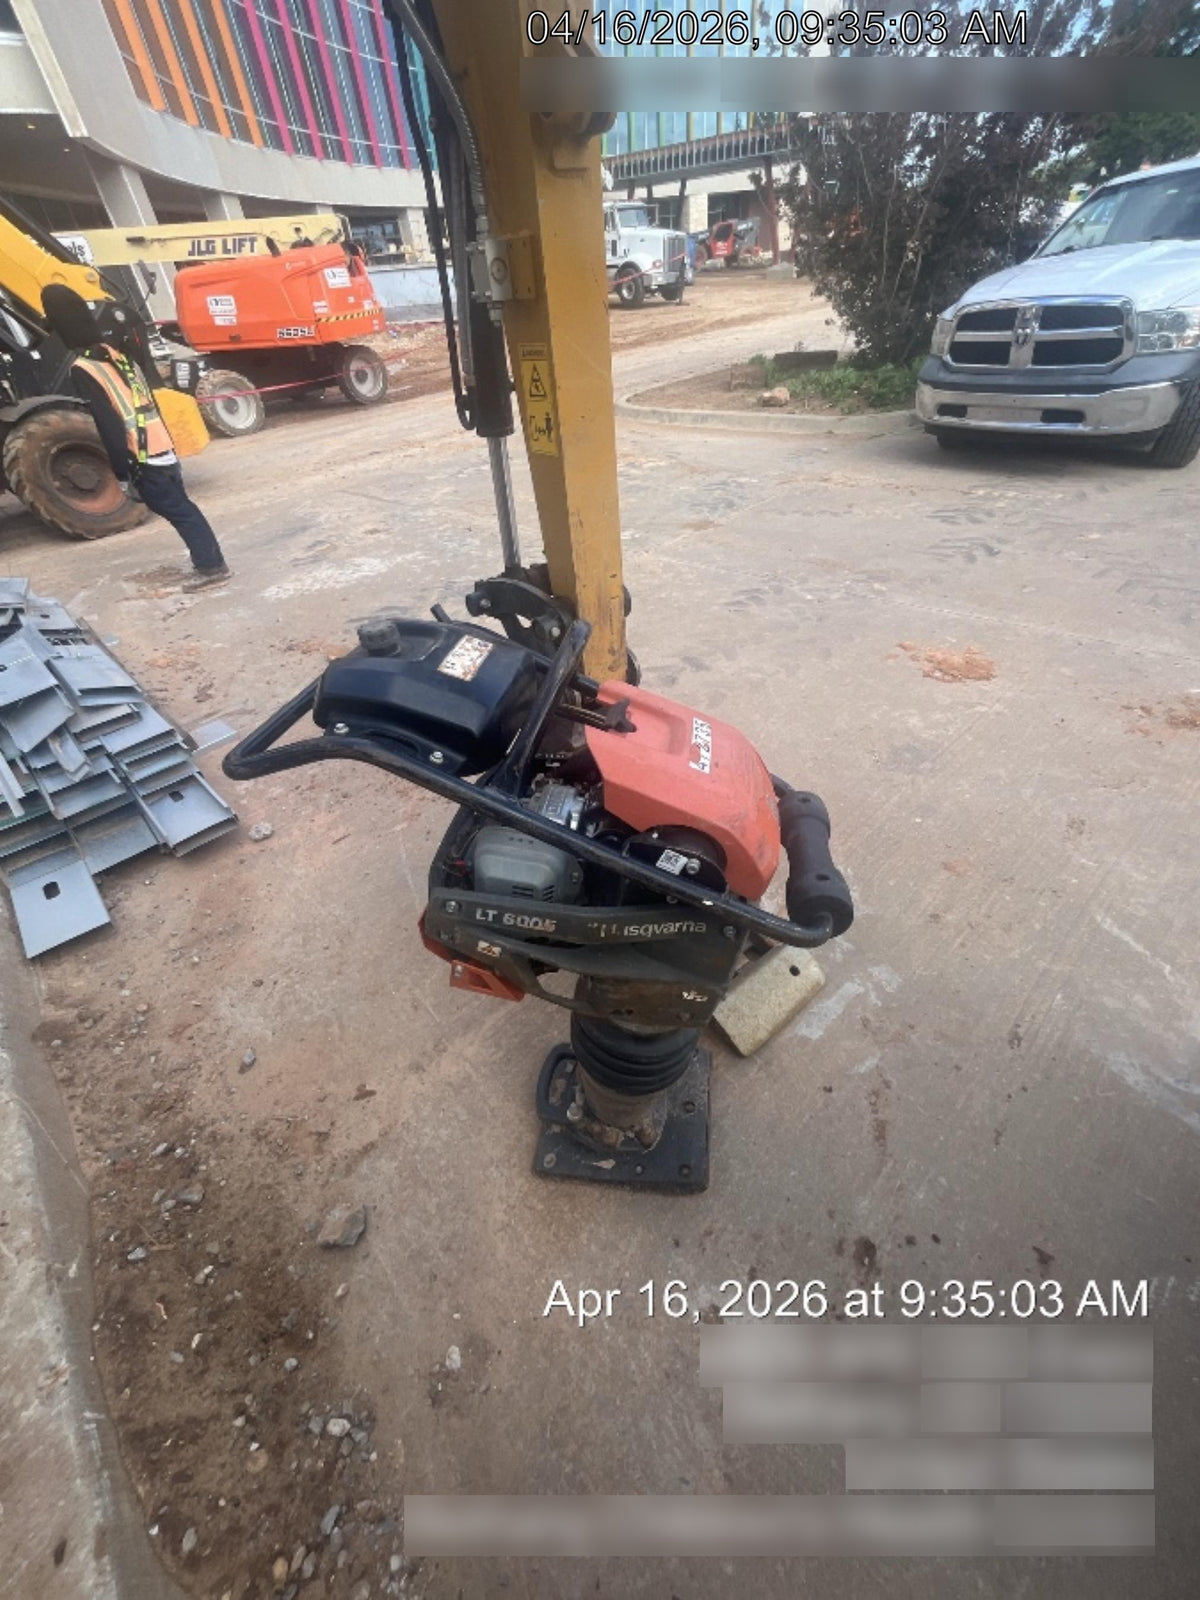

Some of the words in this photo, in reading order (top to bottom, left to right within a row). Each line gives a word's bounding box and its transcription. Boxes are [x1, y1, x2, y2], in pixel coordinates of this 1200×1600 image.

[187, 239, 216, 256] JLG
[222, 236, 258, 254] LIFT
[475, 908, 498, 922] LT
